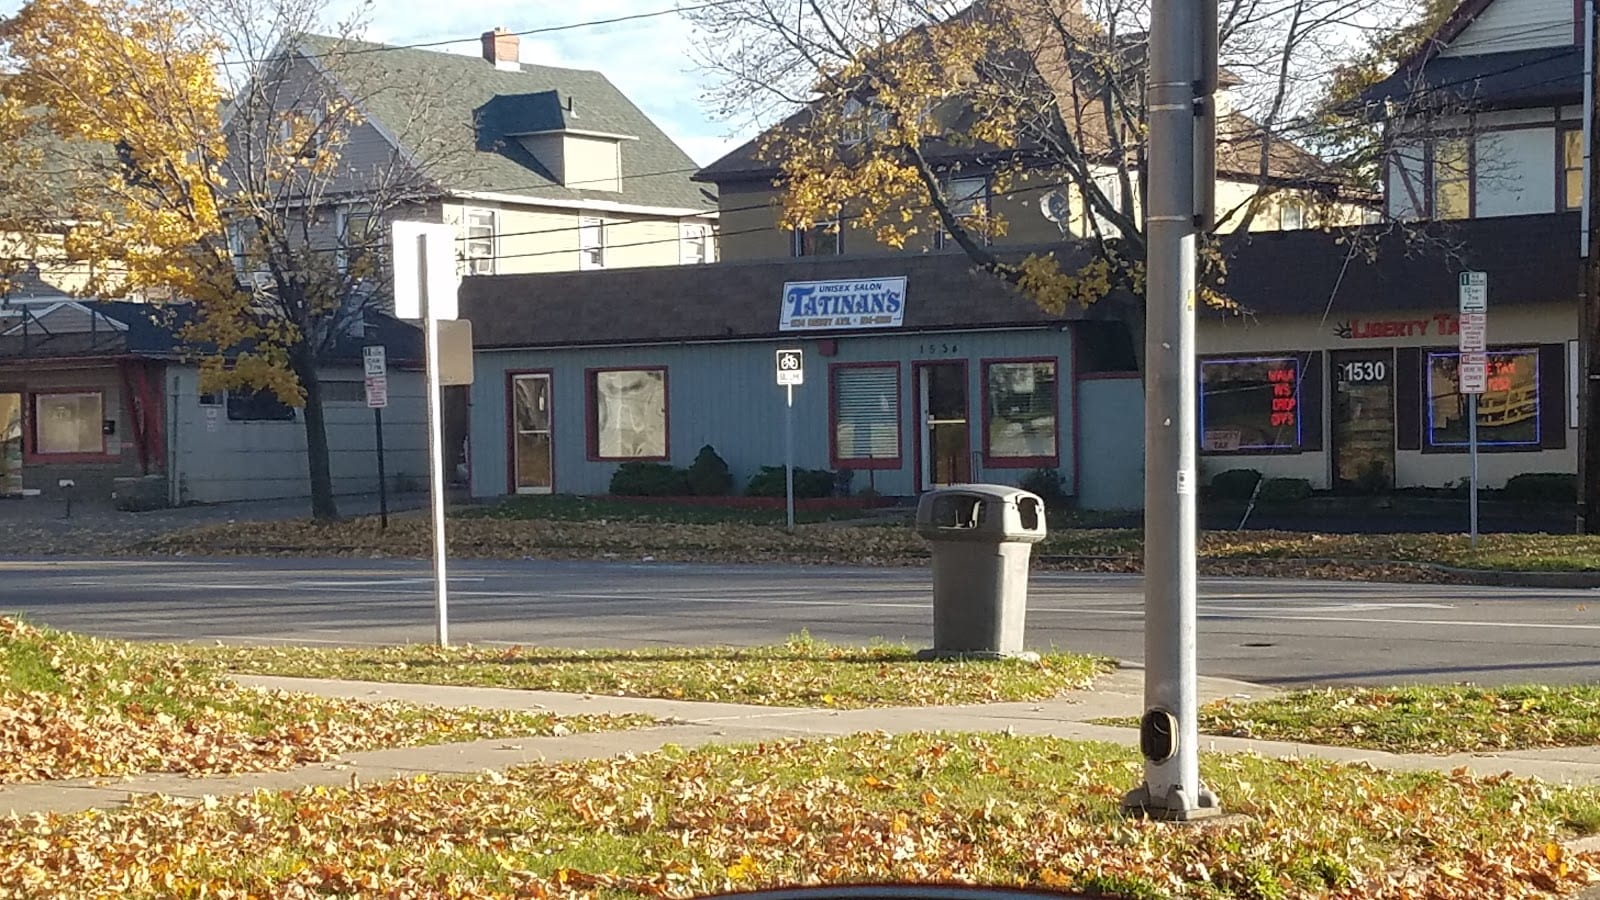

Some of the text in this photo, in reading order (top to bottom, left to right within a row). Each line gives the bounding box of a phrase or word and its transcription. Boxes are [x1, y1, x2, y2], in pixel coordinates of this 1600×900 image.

[819, 282, 882, 293] UNISEX SALON
[787, 286, 901, 317] TATINAN'S
[1351, 319, 1428, 339] LIBERTY
[1345, 361, 1386, 381] 1530
